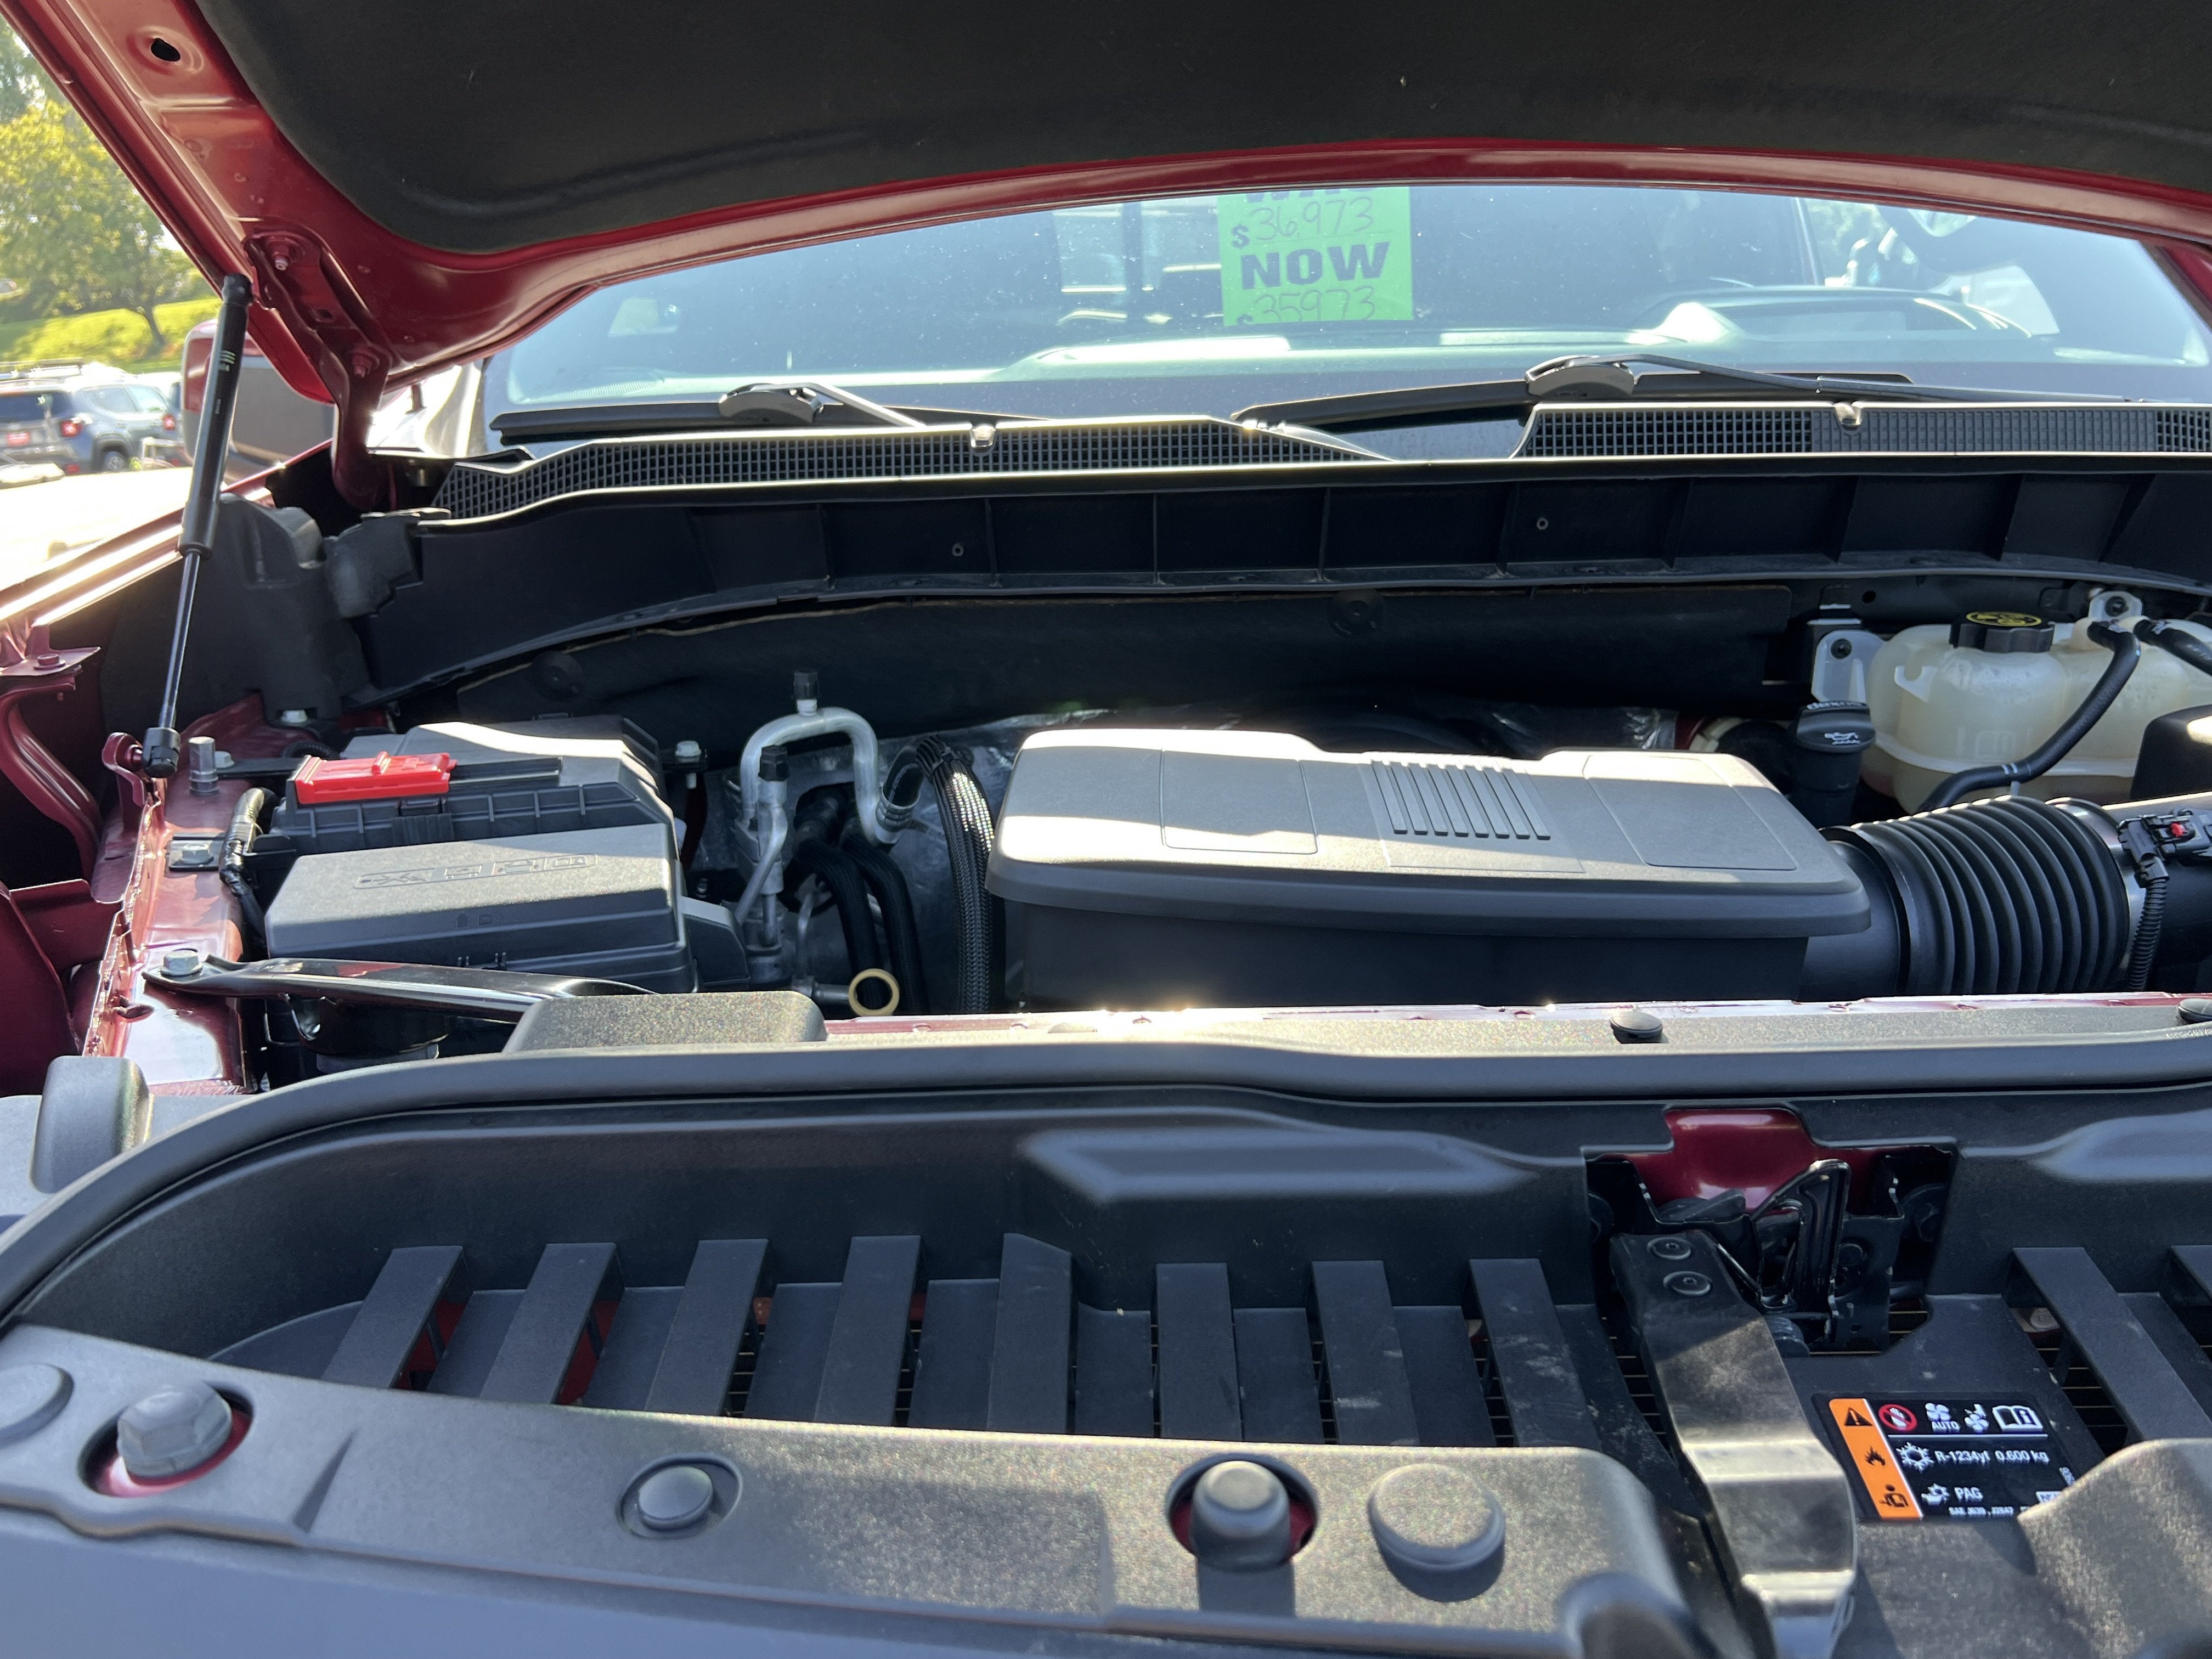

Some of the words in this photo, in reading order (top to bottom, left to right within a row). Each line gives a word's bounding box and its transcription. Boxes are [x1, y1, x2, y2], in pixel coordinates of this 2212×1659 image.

[1241, 242, 1390, 290] NOW
[1931, 1421, 1960, 1433] AUTO
[1995, 1450, 2030, 1463] 0.600
[2030, 1449, 2050, 1464] kg
[1954, 1487, 1983, 1502] PAG
